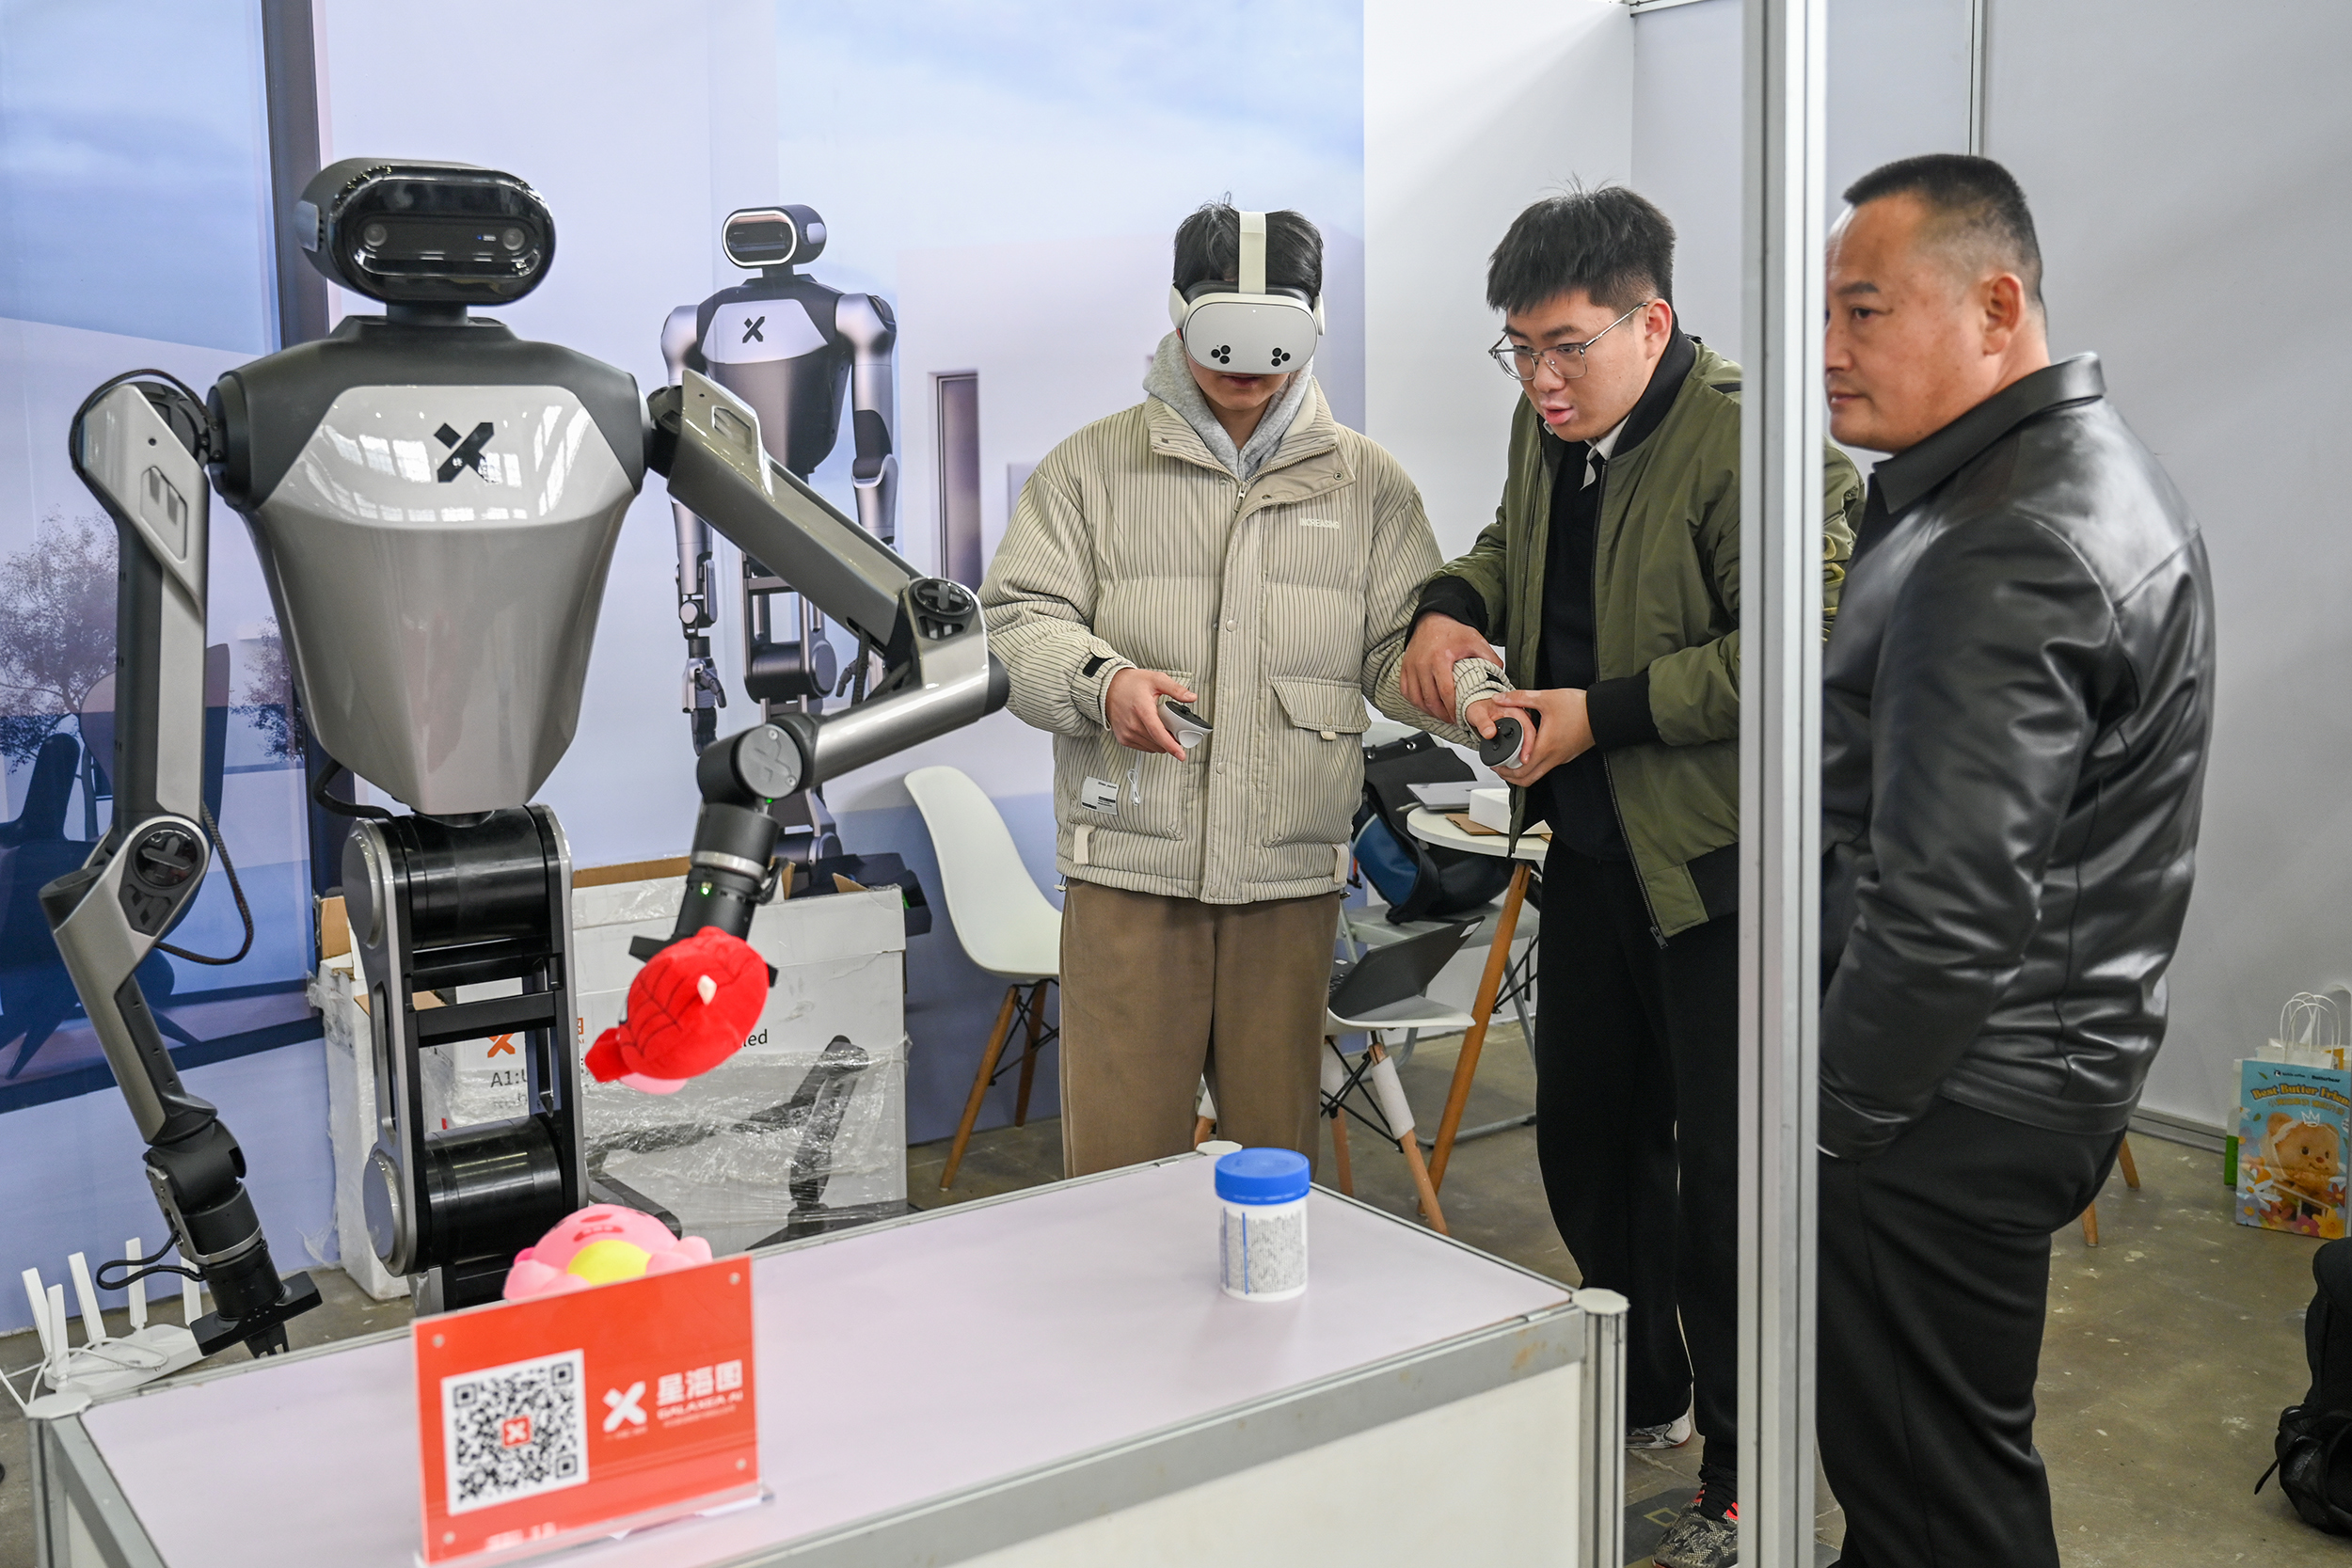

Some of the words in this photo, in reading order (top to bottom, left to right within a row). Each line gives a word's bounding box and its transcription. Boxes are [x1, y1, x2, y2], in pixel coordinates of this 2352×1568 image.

[743, 1028, 768, 1047] ed
[2250, 1085, 2279, 1100] Best
[2280, 1084, 2319, 1096] Butter
